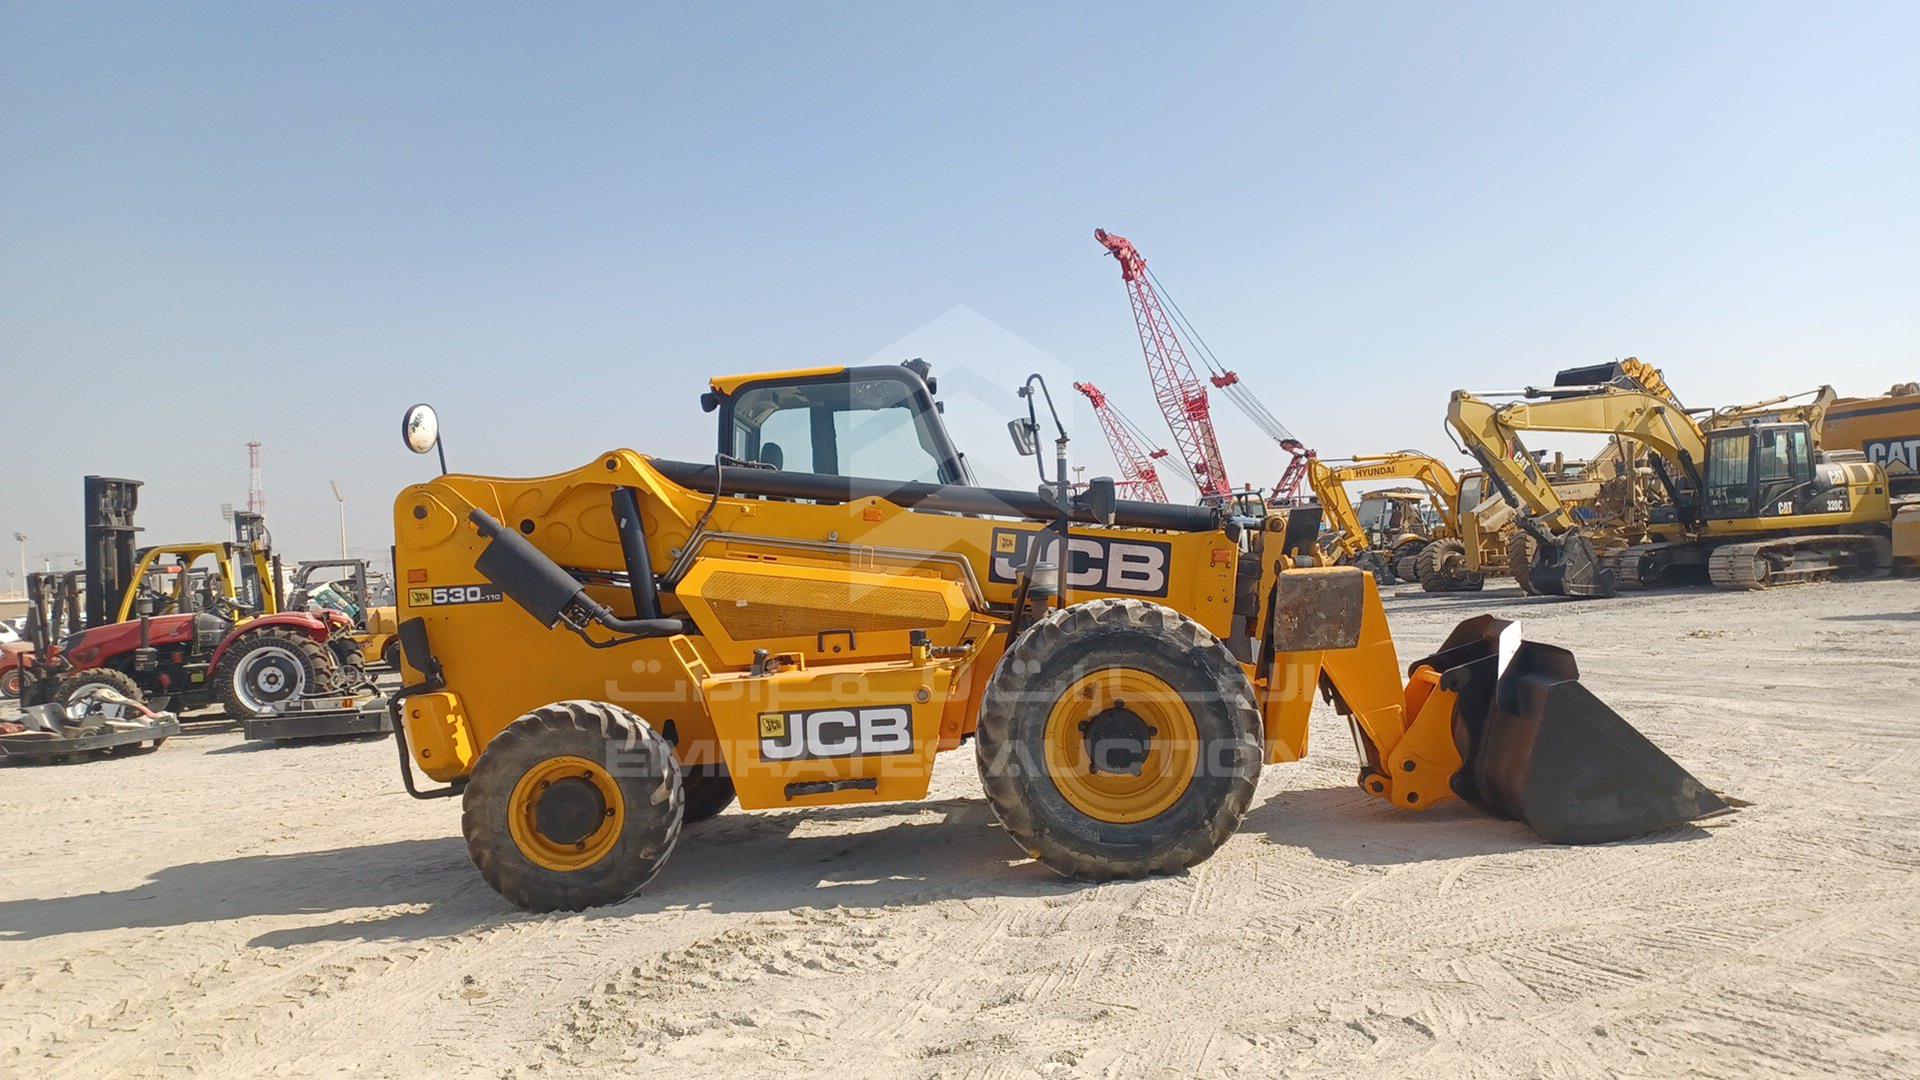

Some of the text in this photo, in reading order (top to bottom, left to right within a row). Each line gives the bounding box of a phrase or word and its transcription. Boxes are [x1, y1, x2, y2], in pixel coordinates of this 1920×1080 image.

[1513, 451, 1531, 472] CAT
[1869, 440, 1920, 474] CAT
[1355, 466, 1395, 478] HYUNDAI
[1828, 470, 1846, 485] CAT
[1778, 501, 1793, 514] CAT
[1827, 500, 1843, 511] 320C
[994, 535, 1165, 592] JCB
[764, 718, 782, 732] JCB
[762, 708, 911, 759] JCB
